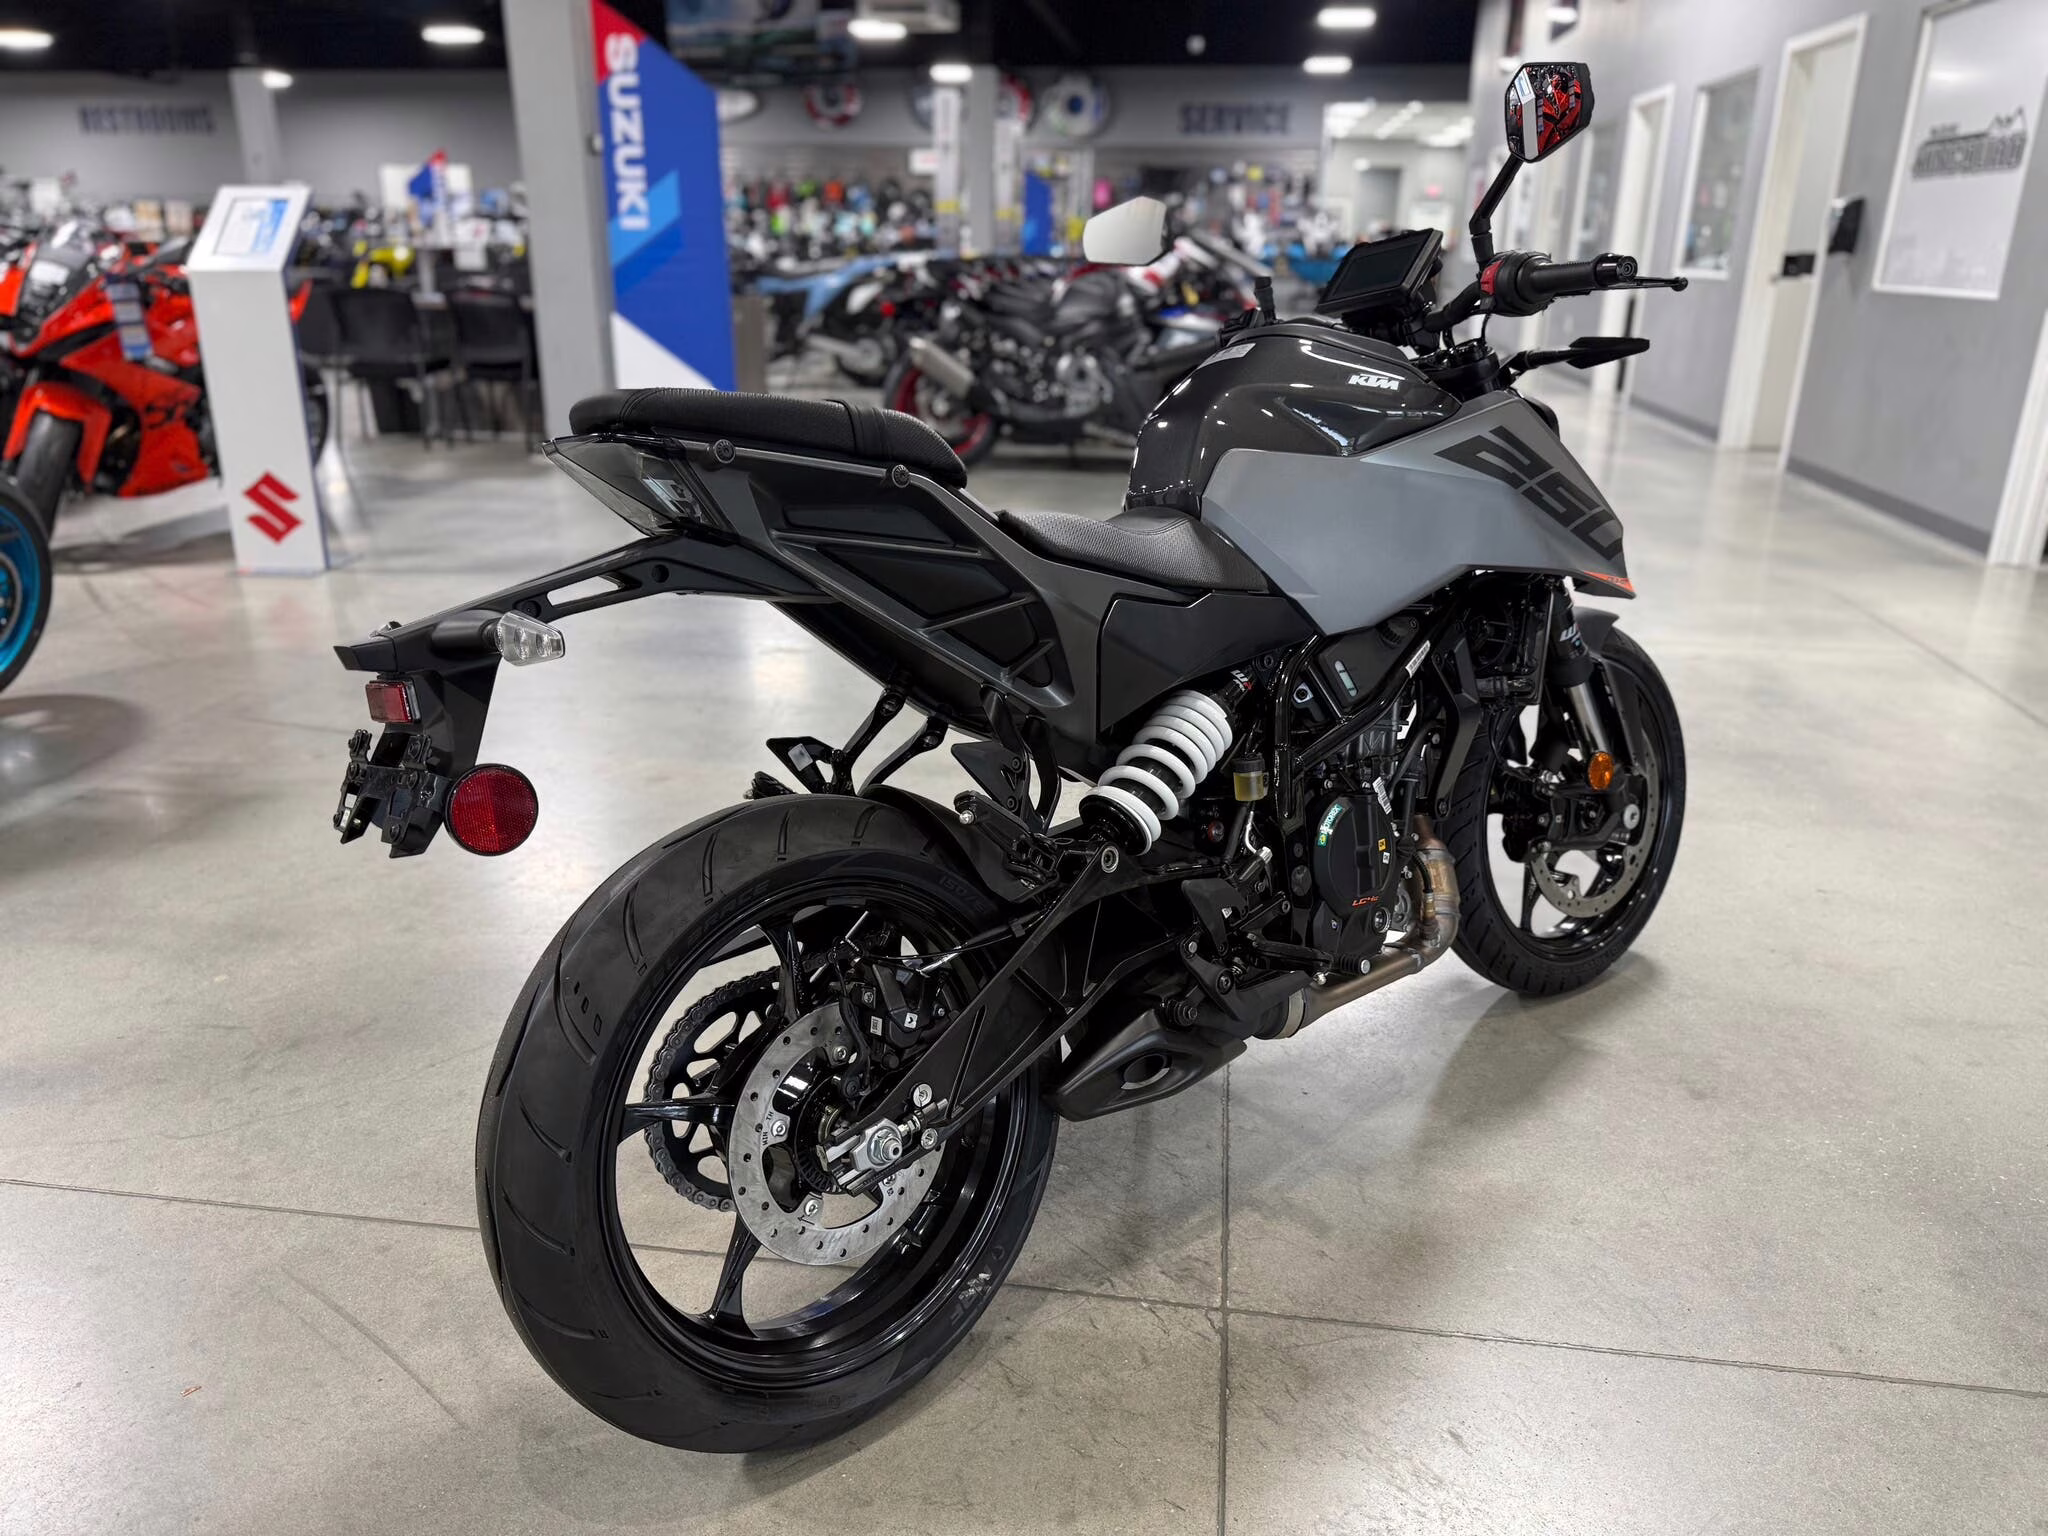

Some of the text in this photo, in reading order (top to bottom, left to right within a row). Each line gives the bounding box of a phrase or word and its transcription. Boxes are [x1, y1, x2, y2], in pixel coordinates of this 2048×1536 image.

[604, 32, 651, 231] SUZUKI
[1347, 373, 1400, 391] KTM
[1433, 425, 1624, 561] 250
